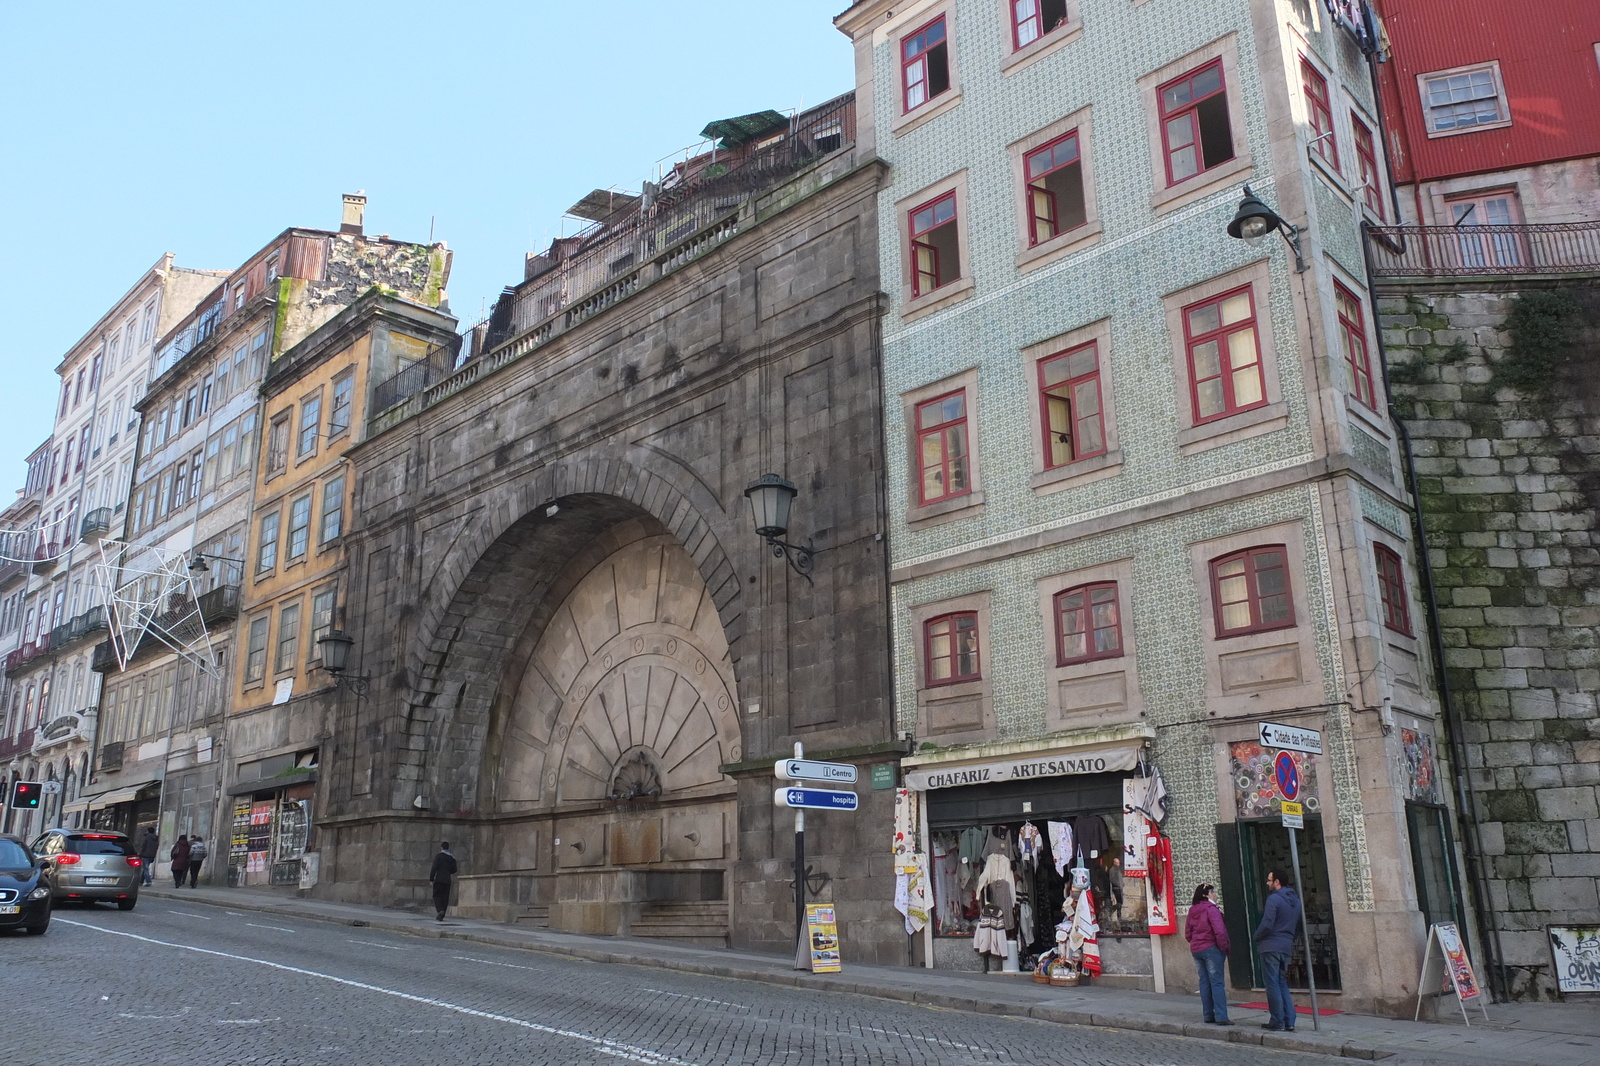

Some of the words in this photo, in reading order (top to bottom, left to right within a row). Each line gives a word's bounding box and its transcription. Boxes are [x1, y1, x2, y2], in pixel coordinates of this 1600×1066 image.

[1274, 729, 1290, 744] Cidade
[1291, 732, 1300, 746] das
[832, 768, 852, 778] Centro
[927, 768, 991, 788] CHAFARIZ
[1010, 758, 1106, 778] ARTESANATO
[832, 795, 856, 805] hospital
